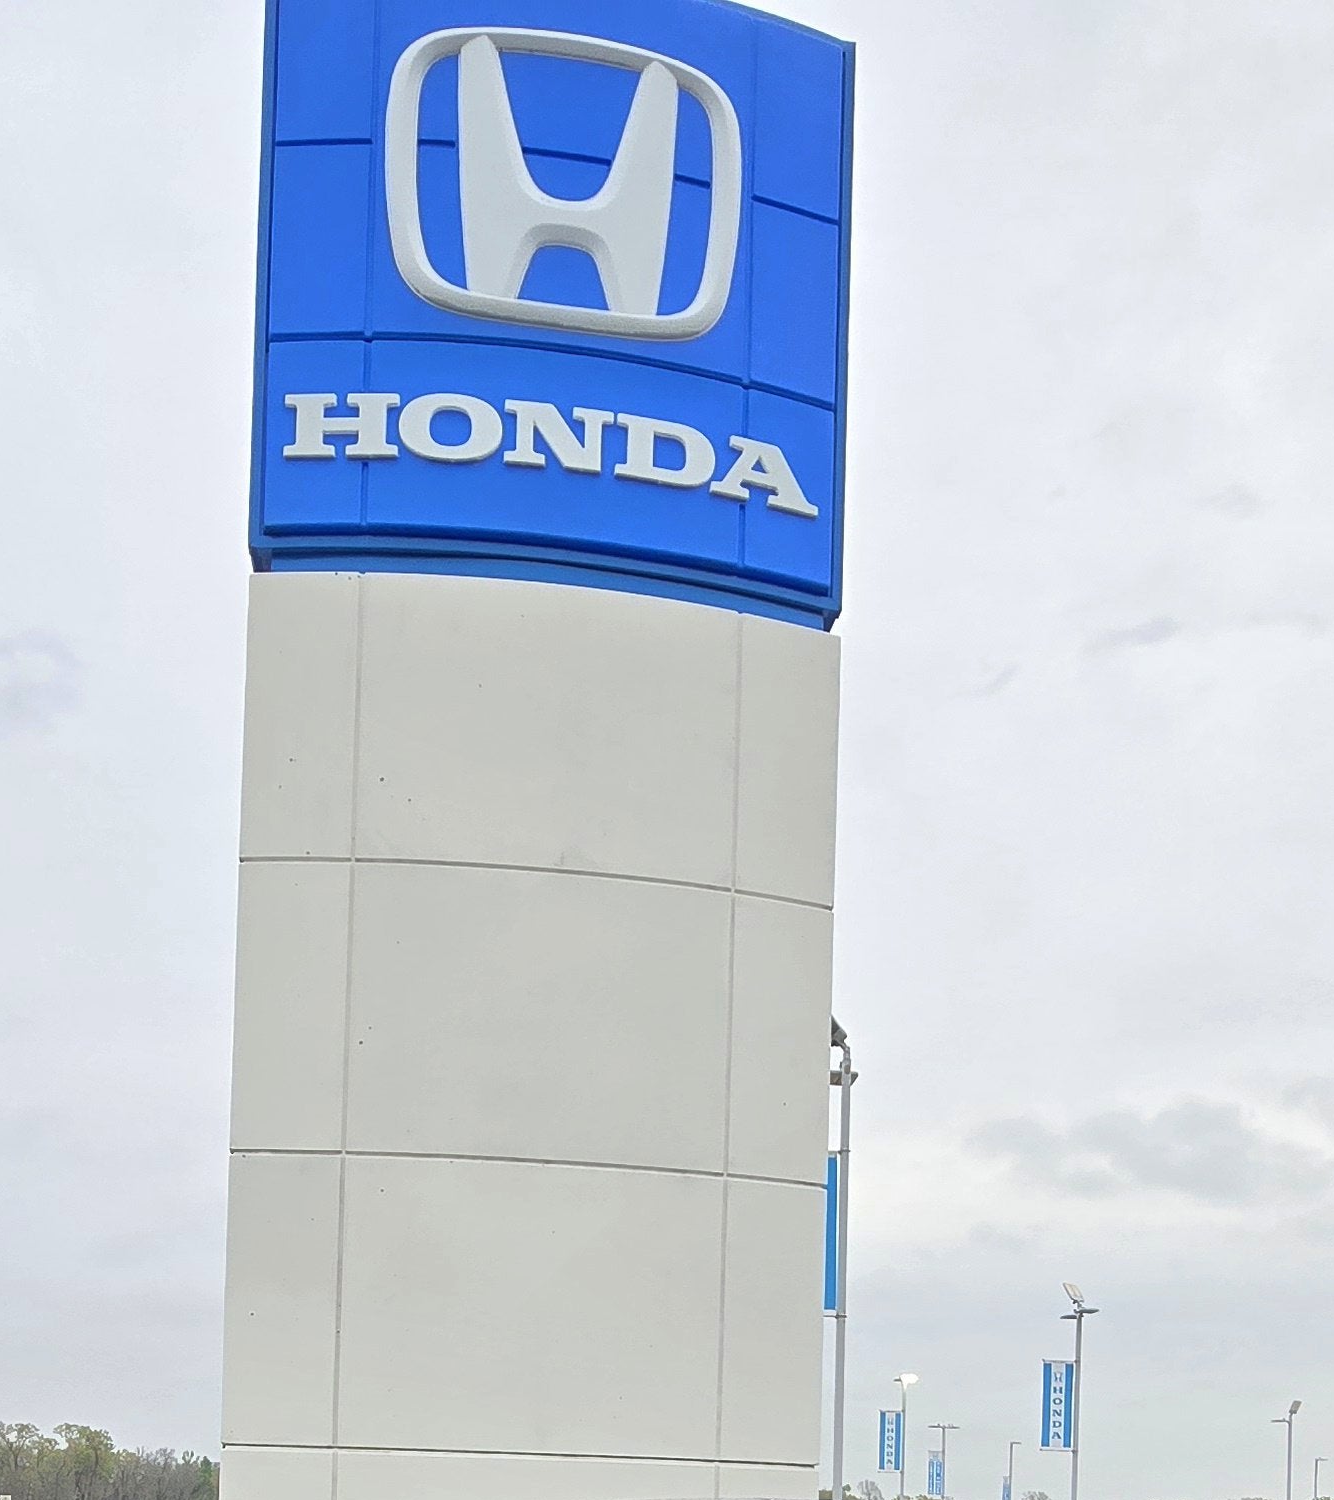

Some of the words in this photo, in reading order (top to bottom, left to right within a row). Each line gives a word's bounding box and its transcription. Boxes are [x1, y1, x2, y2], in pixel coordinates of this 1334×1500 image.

[283, 392, 818, 517] HONDA
[1051, 1386, 1063, 1440] HONDA
[886, 1427, 894, 1465] HONDA
